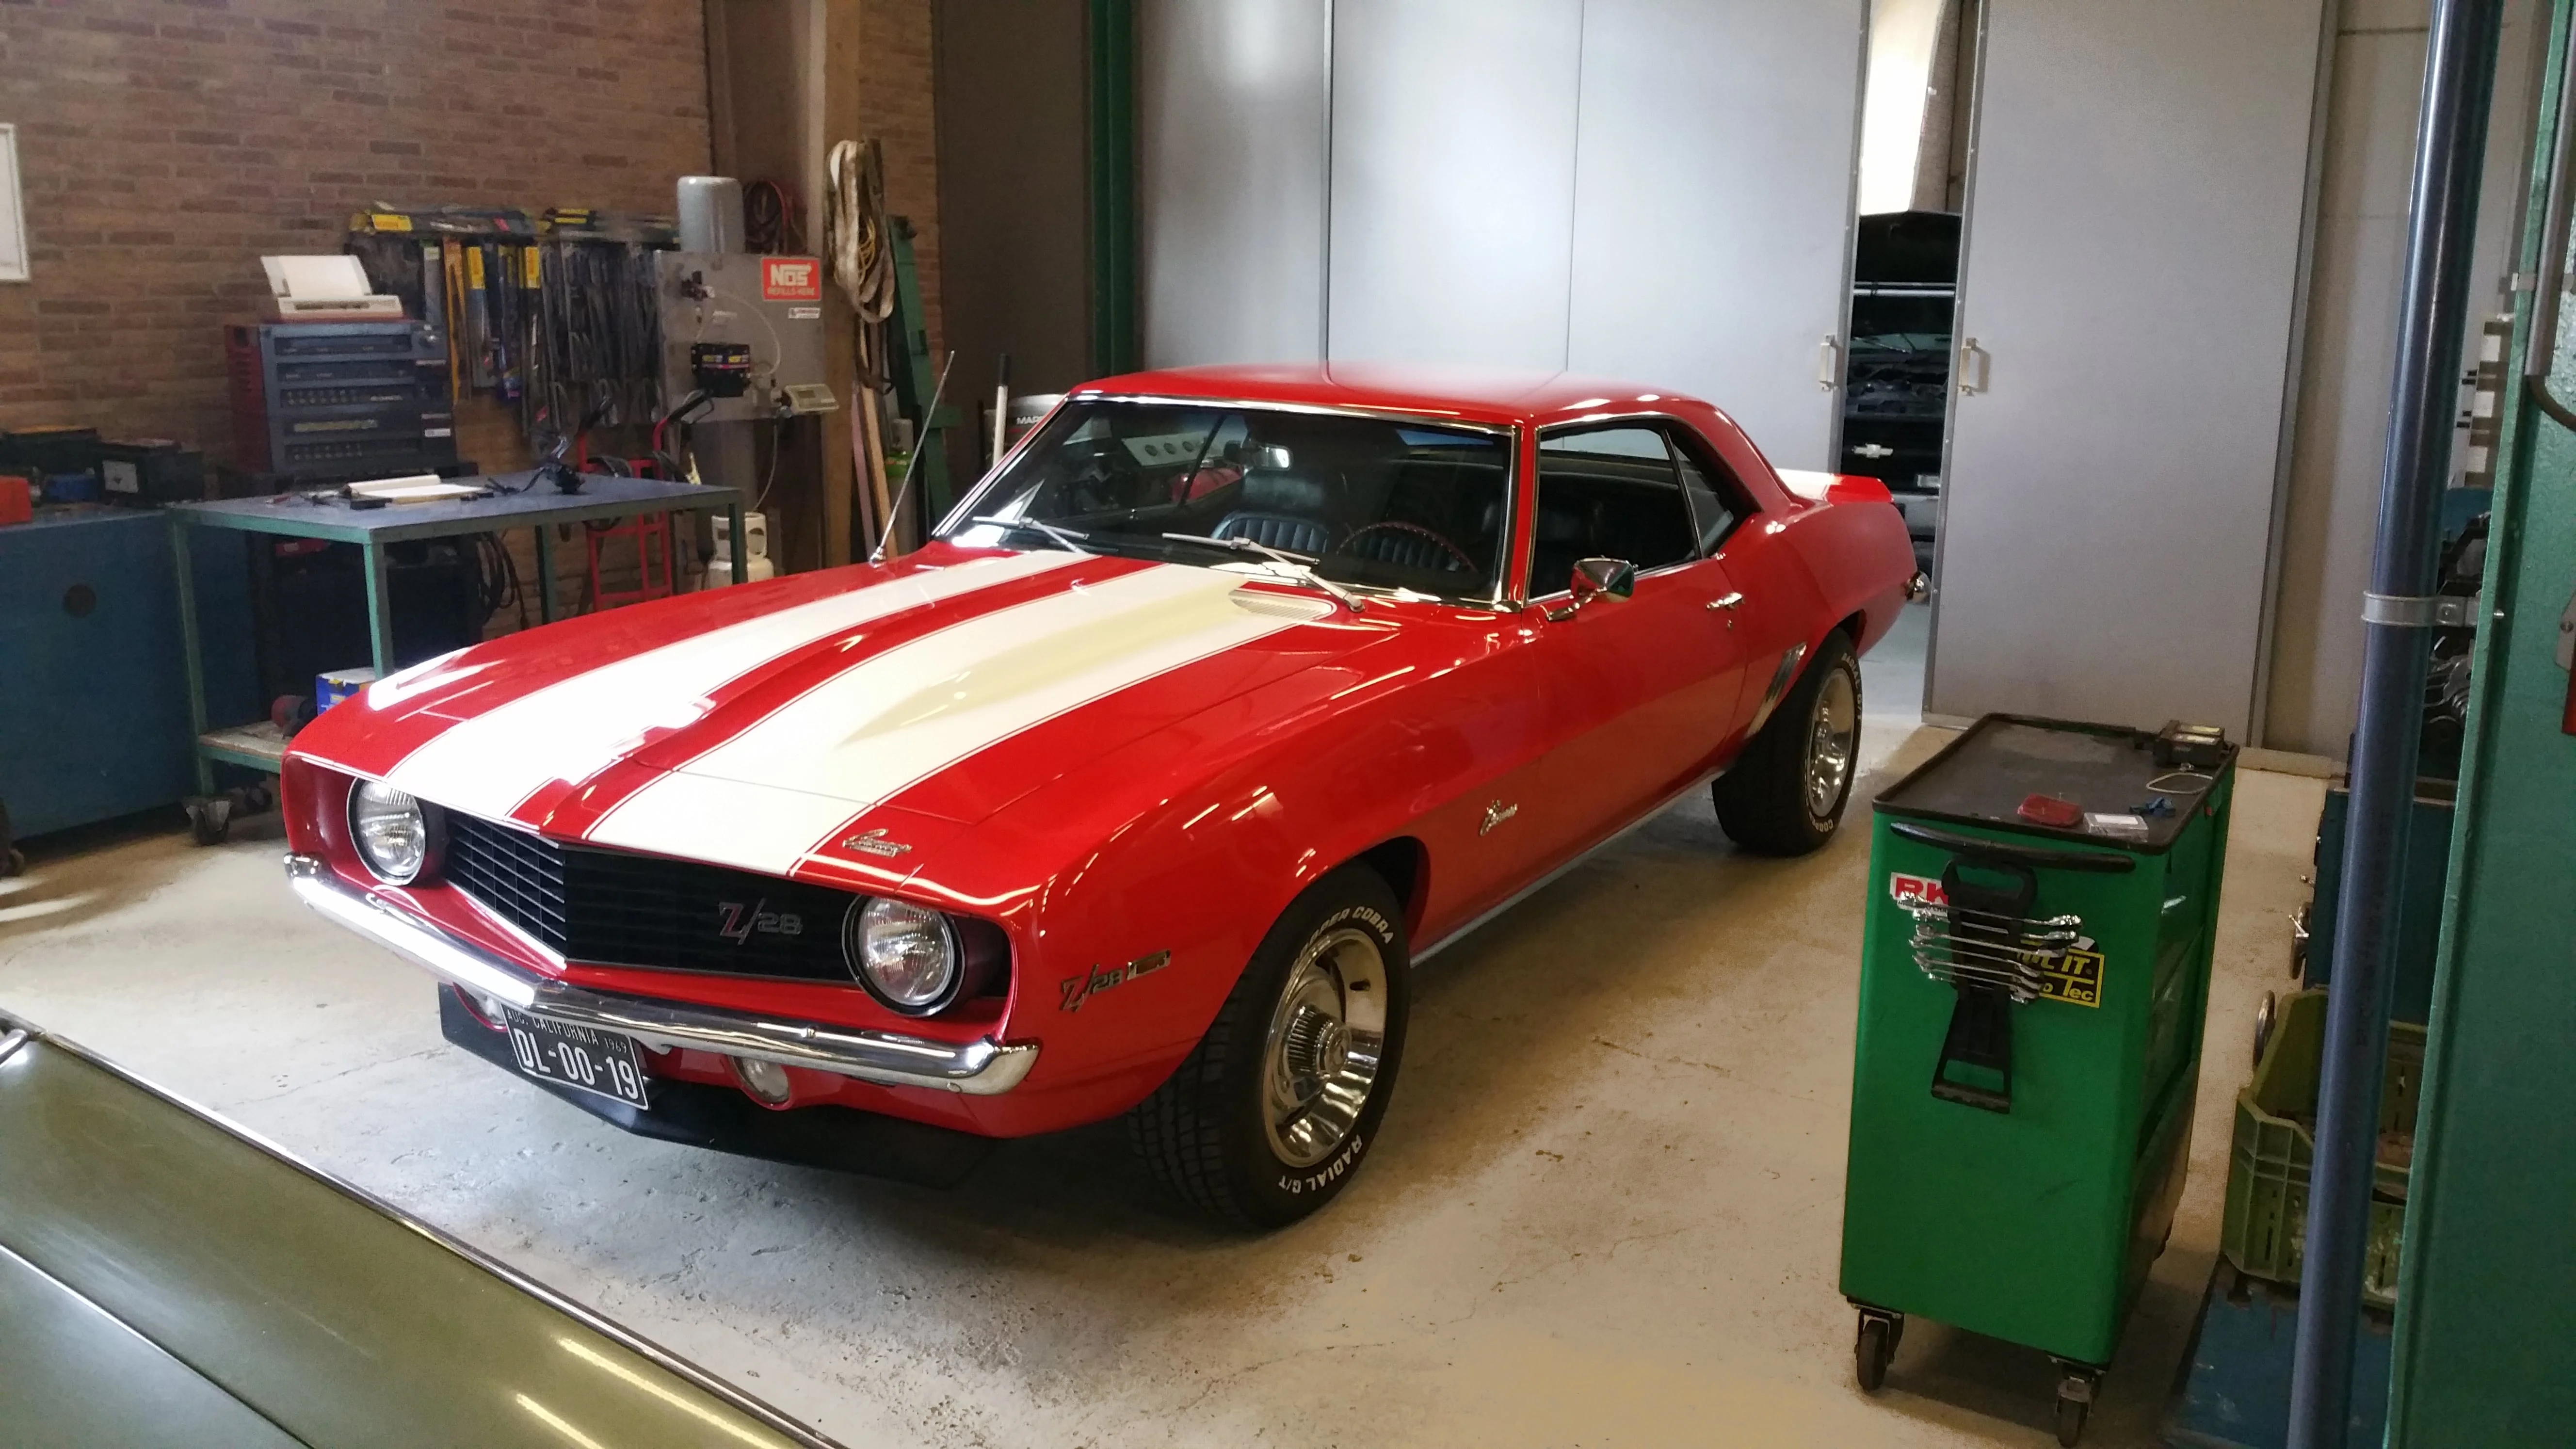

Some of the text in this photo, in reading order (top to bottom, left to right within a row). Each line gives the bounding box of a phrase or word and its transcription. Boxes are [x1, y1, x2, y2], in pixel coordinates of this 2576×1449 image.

[770, 263, 812, 286] NOS
[719, 897, 803, 946] Z/28
[1352, 905, 1394, 944] COBRA
[1059, 964, 1123, 1013] Z/28
[2063, 978, 2094, 1001] Tec
[532, 1016, 599, 1046] CALIFORNIA
[604, 1037, 627, 1054] 1969
[513, 1028, 639, 1099] DL-00-19
[1305, 1134, 1362, 1191] RADIAL
